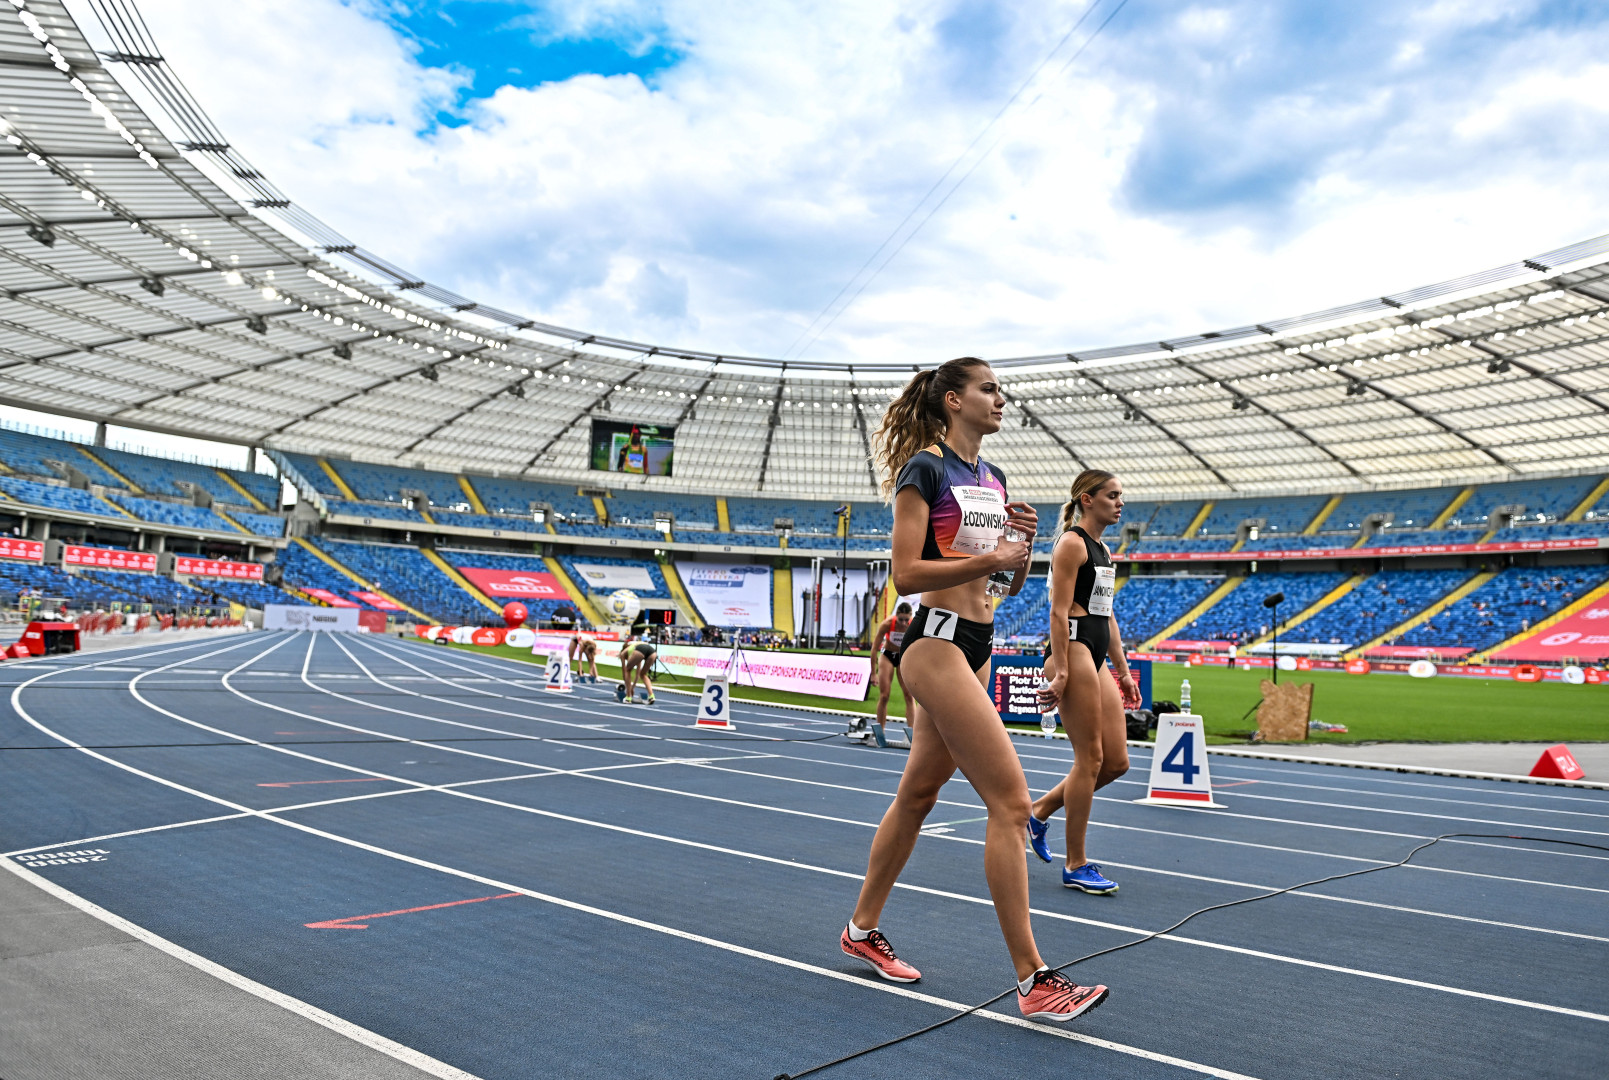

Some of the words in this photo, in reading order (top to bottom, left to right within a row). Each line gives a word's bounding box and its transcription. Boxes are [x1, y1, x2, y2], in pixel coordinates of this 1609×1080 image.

[963, 510, 1006, 530] ŁOZOWSKA
[934, 610, 952, 636] 7
[550, 662, 561, 683] 2
[770, 665, 798, 678] SPONSOR
[798, 667, 833, 682] POLSKIEGO
[832, 671, 863, 685] SPORTU
[995, 675, 1002, 684] 1
[1009, 676, 1031, 684] Piotr
[996, 666, 1021, 675] 400m
[1023, 667, 1032, 675] M
[995, 685, 1002, 693] 2
[995, 694, 1002, 702] 3
[1009, 695, 1034, 704] Adam
[705, 685, 723, 716] 3
[995, 704, 1001, 712] 4
[1161, 732, 1200, 784] 4
[842, 938, 854, 950] new
[854, 946, 883, 968] balance
